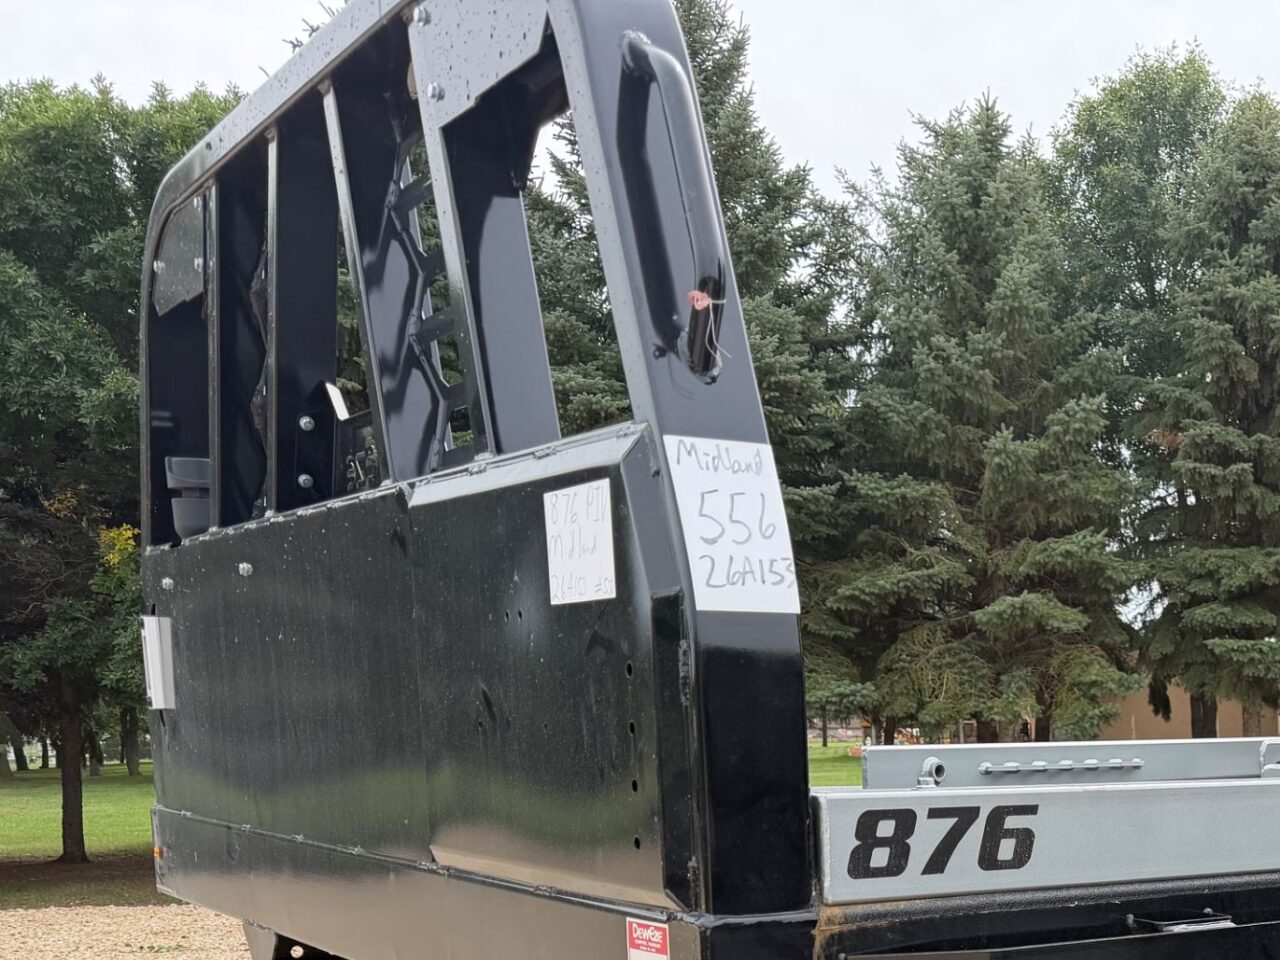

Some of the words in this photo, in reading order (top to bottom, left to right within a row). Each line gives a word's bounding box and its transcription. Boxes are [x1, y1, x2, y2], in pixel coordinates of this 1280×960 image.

[699, 489, 776, 545] 556
[699, 555, 796, 589] 26A153
[847, 804, 1040, 880] 876
